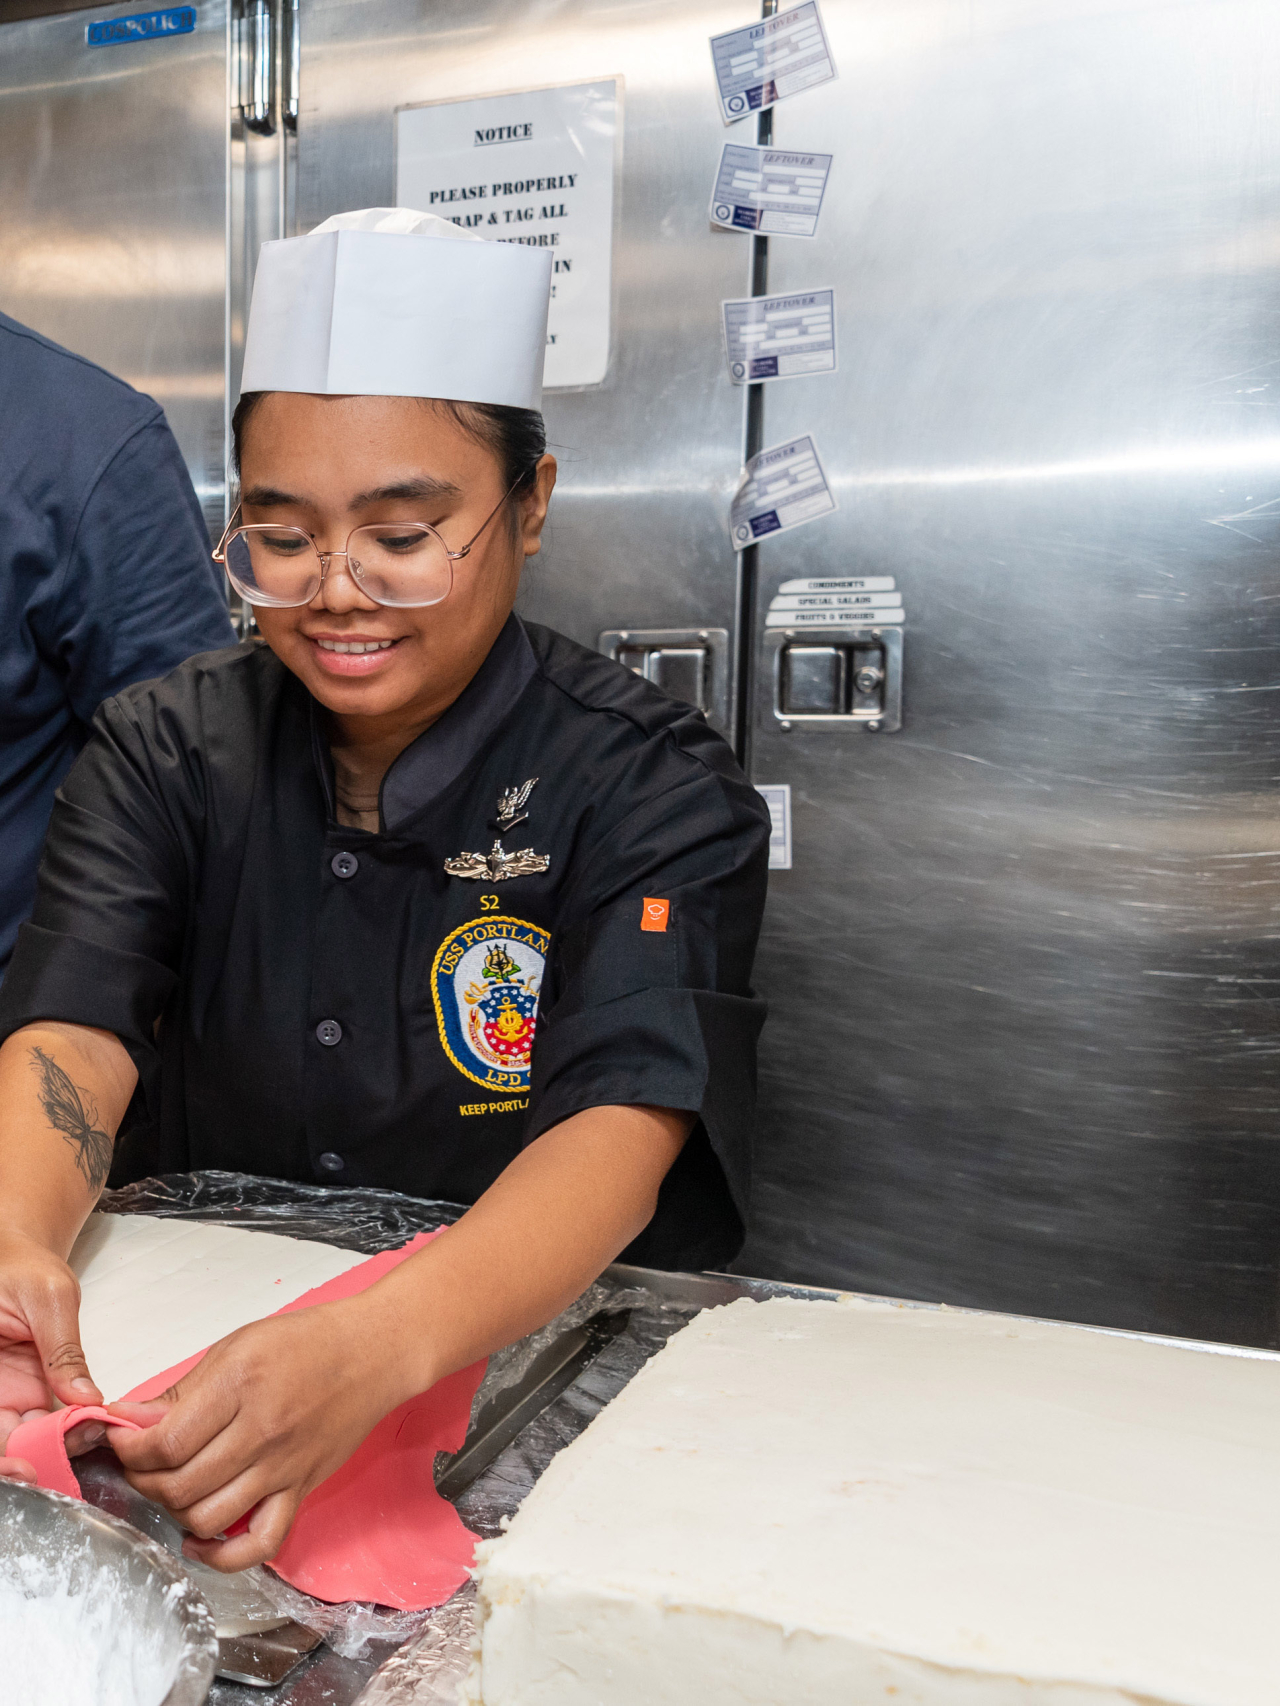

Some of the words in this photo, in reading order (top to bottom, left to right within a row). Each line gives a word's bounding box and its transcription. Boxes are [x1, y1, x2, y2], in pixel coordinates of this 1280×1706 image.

[89, 11, 193, 42] COSPOLICH
[474, 123, 533, 145] NOTICE
[429, 185, 487, 204] PLEASE
[492, 174, 578, 198] PROPERLY
[445, 214, 483, 228] RAP
[487, 211, 498, 225] &
[503, 207, 534, 223] TAG
[538, 204, 568, 220] ALL
[554, 259, 572, 273] IN
[798, 597, 833, 605] SPECIAL
[837, 596, 872, 605] SALADS
[795, 612, 826, 621] FRUITS
[480, 895, 500, 911] S2
[439, 946, 464, 976] USS
[462, 923, 549, 956] PORTLAN
[485, 1069, 521, 1086] LPD
[459, 1103, 488, 1116] KEEP
